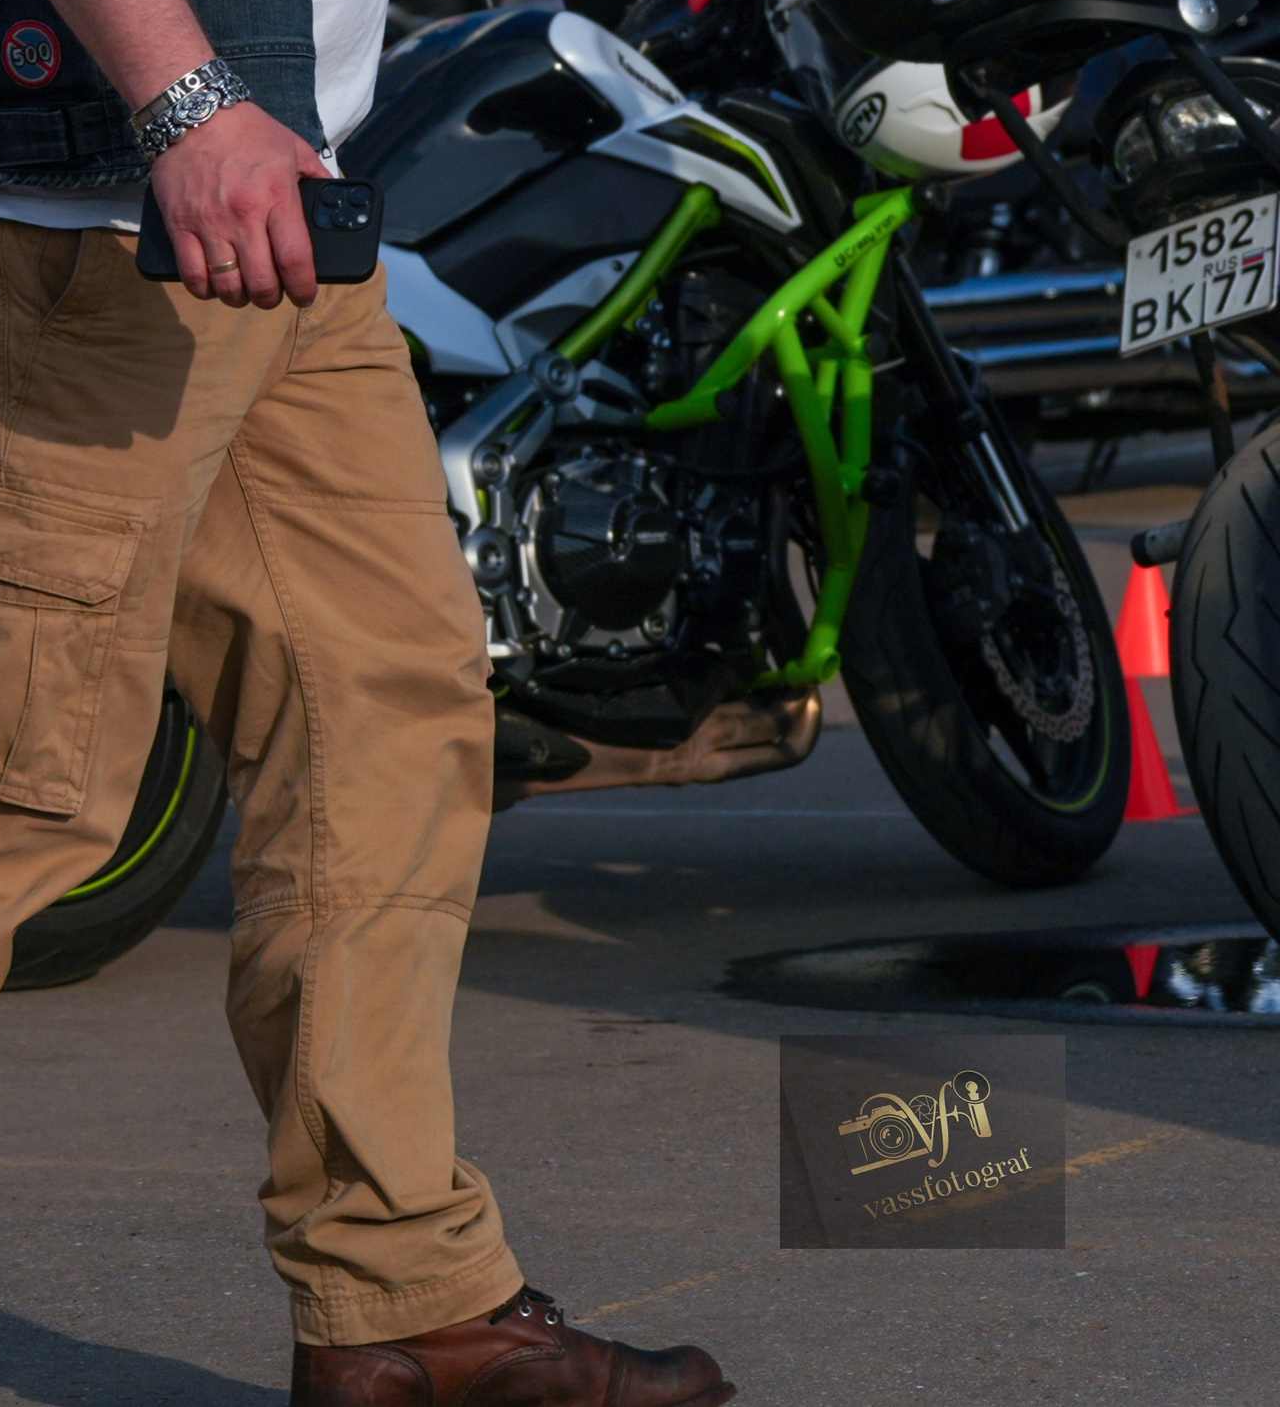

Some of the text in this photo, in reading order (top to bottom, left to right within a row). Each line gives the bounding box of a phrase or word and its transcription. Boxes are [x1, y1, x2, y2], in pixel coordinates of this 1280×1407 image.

[12, 42, 51, 67] 500
[1149, 208, 1255, 274] 1582
[1204, 256, 1238, 278] RUS
[1213, 261, 1265, 315] 77
